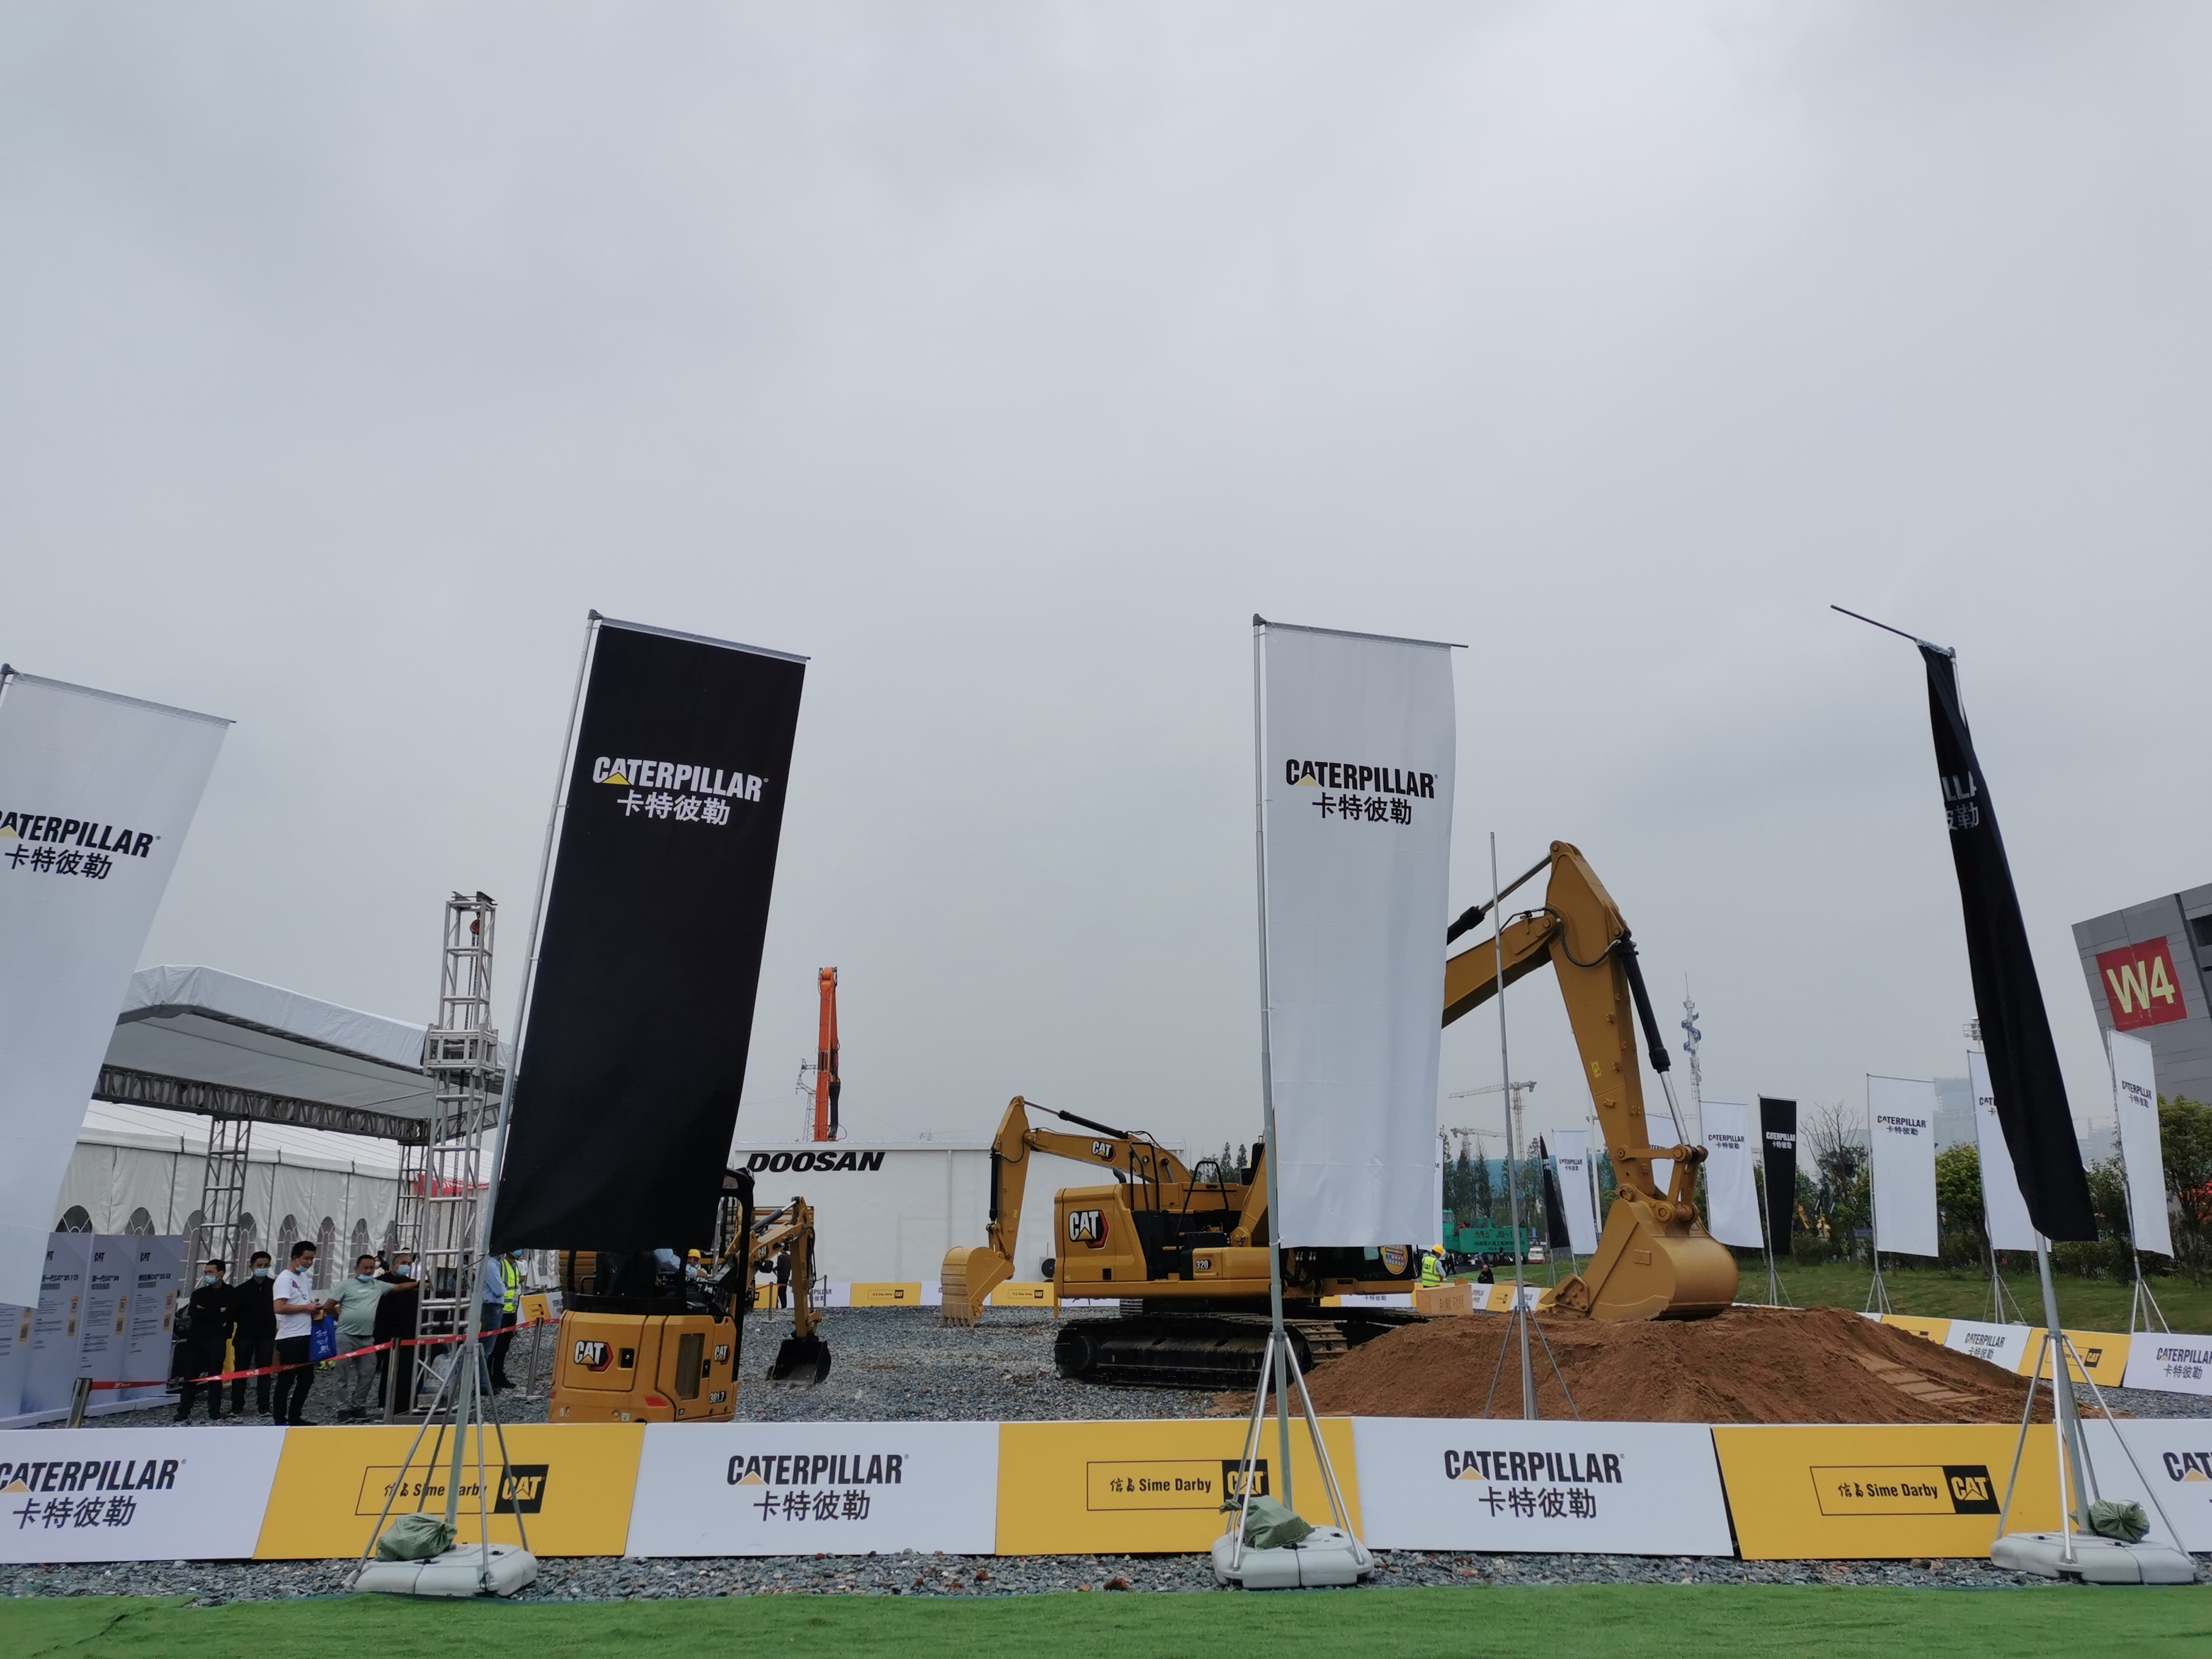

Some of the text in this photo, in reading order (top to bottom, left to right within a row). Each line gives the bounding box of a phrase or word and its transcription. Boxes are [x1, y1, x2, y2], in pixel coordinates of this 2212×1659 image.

[592, 756, 763, 802] CATERPILLAR
[1286, 759, 1435, 799] CATERPILLAR
[617, 789, 731, 825] 卡特彼勒
[1312, 792, 1412, 825] 卡特彼勒
[0, 810, 153, 858] ATERPILLAR
[4, 843, 113, 880] 卡特彼勒
[2106, 956, 2176, 1014] W4
[1877, 1115, 1926, 1128] CATERPILLAR
[1886, 1125, 1919, 1136] 卡特彼勒
[1092, 1141, 1111, 1158] CAT
[1708, 1134, 1744, 1142] CATERPILLAR
[746, 1151, 885, 1172] DOOSAN
[1069, 1211, 1099, 1241] CAT
[95, 1252, 105, 1262] CAT
[140, 1252, 151, 1262] CAT
[1196, 1259, 1208, 1270] 320
[1965, 1332, 2005, 1349] CATERPILLAR
[575, 1341, 604, 1365] CAT
[715, 1346, 728, 1362] CAT
[2163, 1364, 2203, 1379] 卡特彼勒
[709, 1392, 725, 1404] 301.7
[0, 1460, 179, 1492] CATERPILLAR
[727, 1455, 903, 1486] CATERPILLAR
[1444, 1450, 1623, 1484] CATERPILLAR
[413, 1483, 444, 1496] Sme
[458, 1483, 487, 1499] arby
[501, 1476, 542, 1501] CAT
[1139, 1478, 1170, 1492] Sime
[1175, 1478, 1212, 1493] Darby
[1868, 1483, 1899, 1497] Sime
[1901, 1483, 1938, 1499] Darby
[1951, 1476, 1989, 1501] CAT
[12, 1495, 138, 1529] 卡特彼勒
[753, 1489, 871, 1522] 卡特彼勒
[1478, 1486, 1597, 1519] 卡特彼勒
